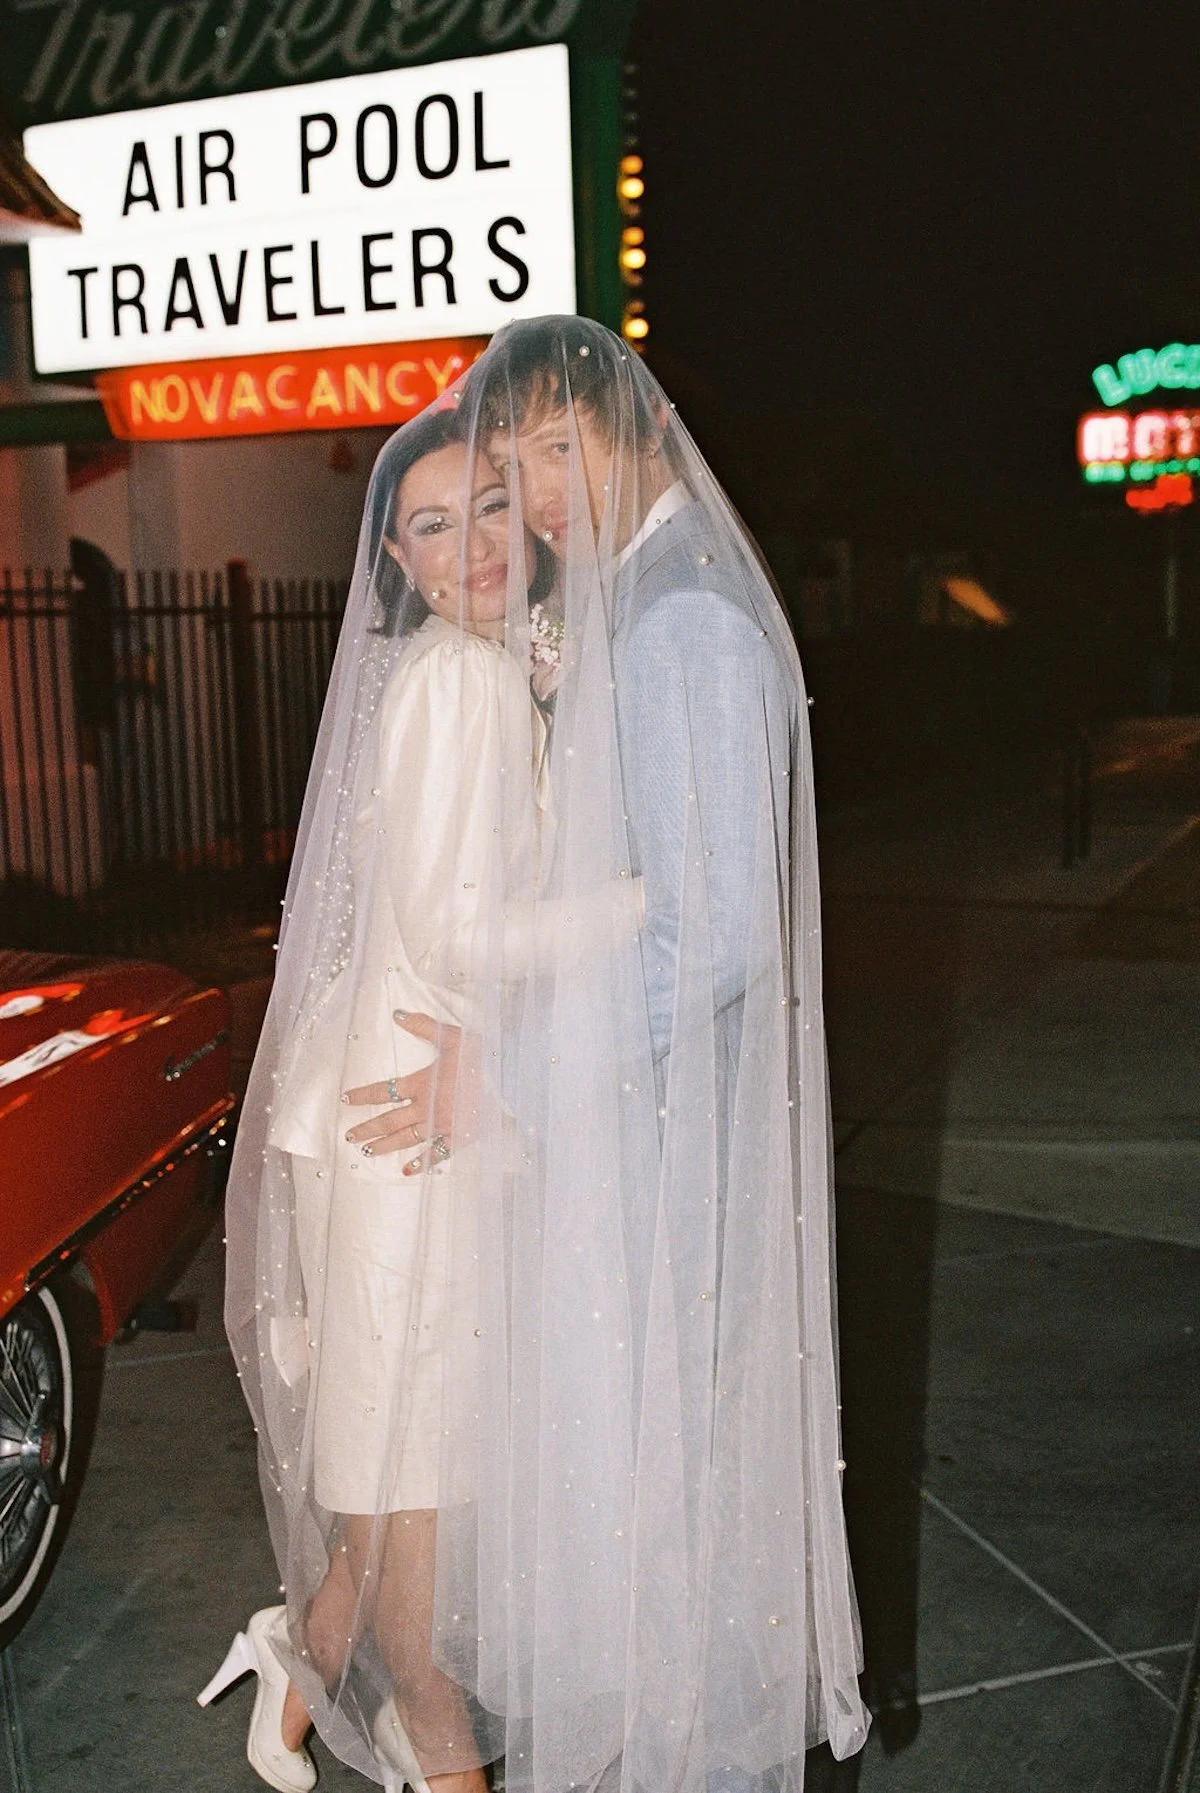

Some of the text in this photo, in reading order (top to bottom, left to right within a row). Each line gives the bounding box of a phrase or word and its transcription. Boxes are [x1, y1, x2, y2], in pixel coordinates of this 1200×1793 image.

[122, 91, 510, 217] AIR POOL
[67, 216, 530, 339] TRAVELERS
